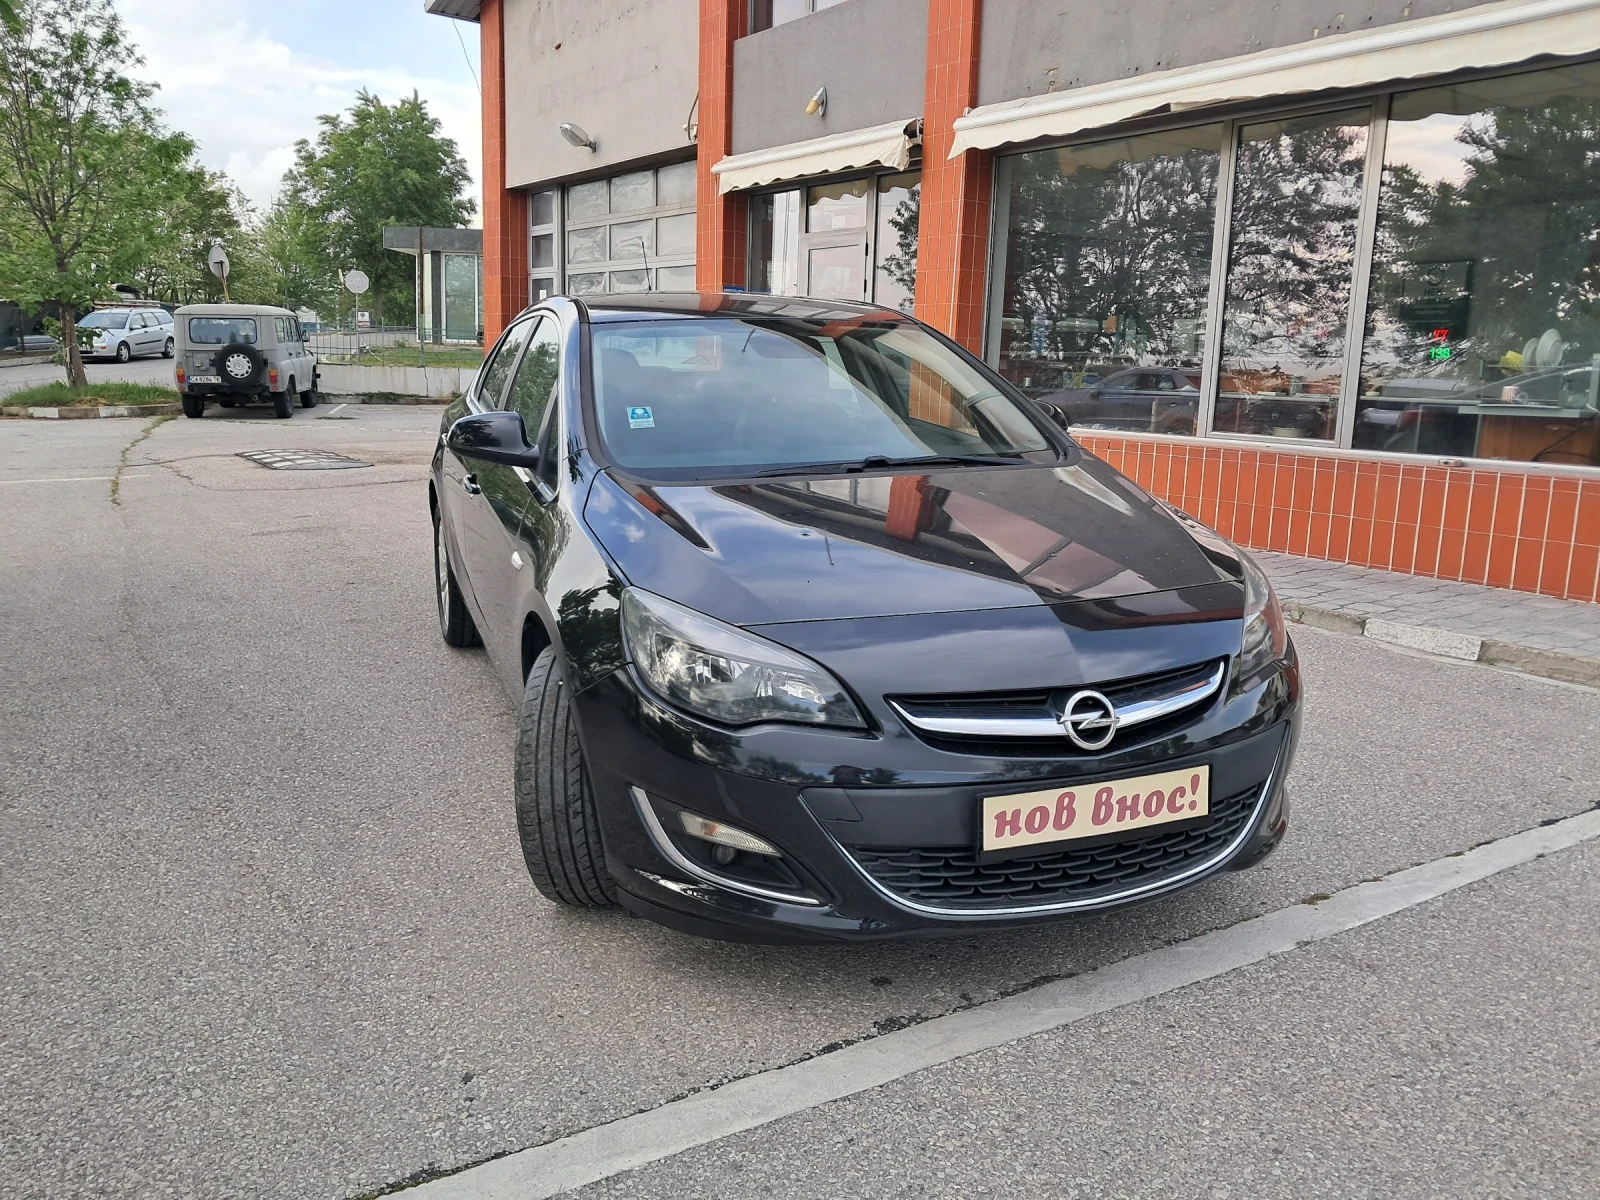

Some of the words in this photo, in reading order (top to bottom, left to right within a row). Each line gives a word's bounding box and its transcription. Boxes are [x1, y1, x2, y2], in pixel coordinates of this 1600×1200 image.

[1430, 347, 1451, 359] 138
[994, 791, 1077, 838] нов
[1091, 773, 1200, 826] внос!
